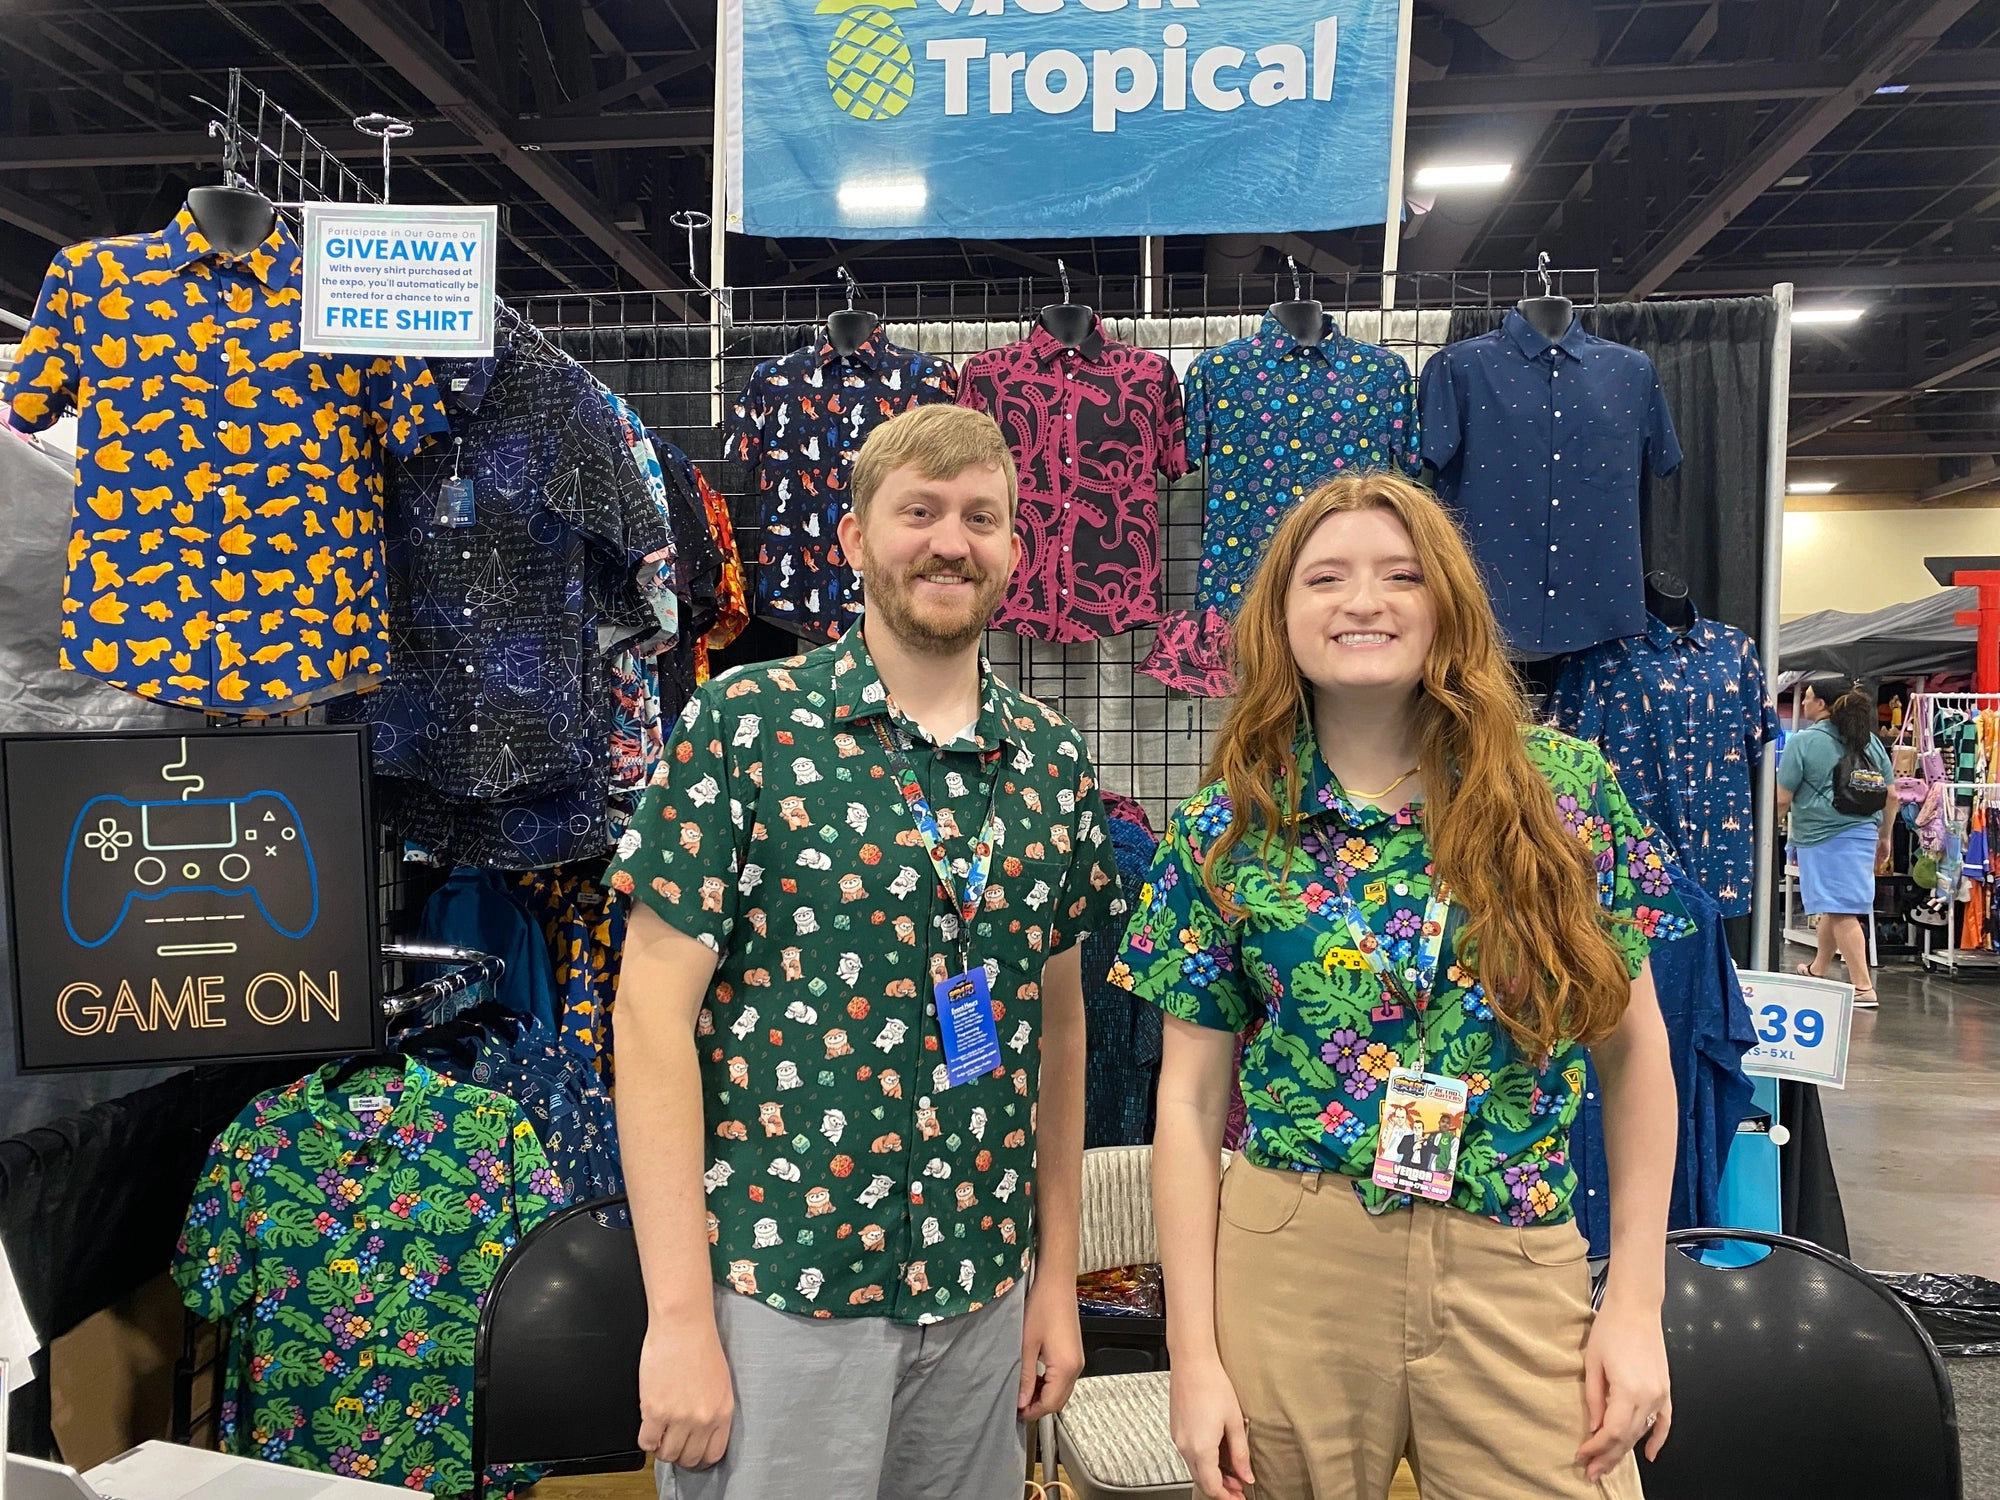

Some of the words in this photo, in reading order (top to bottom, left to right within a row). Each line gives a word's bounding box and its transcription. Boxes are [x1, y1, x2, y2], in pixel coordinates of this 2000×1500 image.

[926, 16, 1338, 132] Tropical
[328, 228, 387, 238] Participate
[404, 229, 423, 238] Our
[427, 230, 458, 239] Game
[462, 231, 476, 239] On
[326, 238, 477, 262] GIVEAWAY
[329, 264, 352, 273] With
[354, 266, 382, 275] every
[384, 266, 406, 274] shirt
[408, 267, 461, 276] purchased
[462, 268, 472, 276] at
[322, 278, 338, 286] the
[339, 280, 366, 289] expo,
[368, 279, 395, 289] you'll
[397, 280, 464, 291] automatically
[467, 281, 479, 289] be
[330, 292, 369, 300] entered
[371, 292, 385, 300] for
[395, 293, 431, 302] chance
[433, 294, 443, 302] to
[445, 294, 461, 302] win
[326, 307, 388, 329] FREE
[396, 309, 473, 331] SHIRT
[57, 976, 227, 1036] GAME
[246, 970, 340, 1026] ON
[1746, 1004, 1825, 1048] 39
